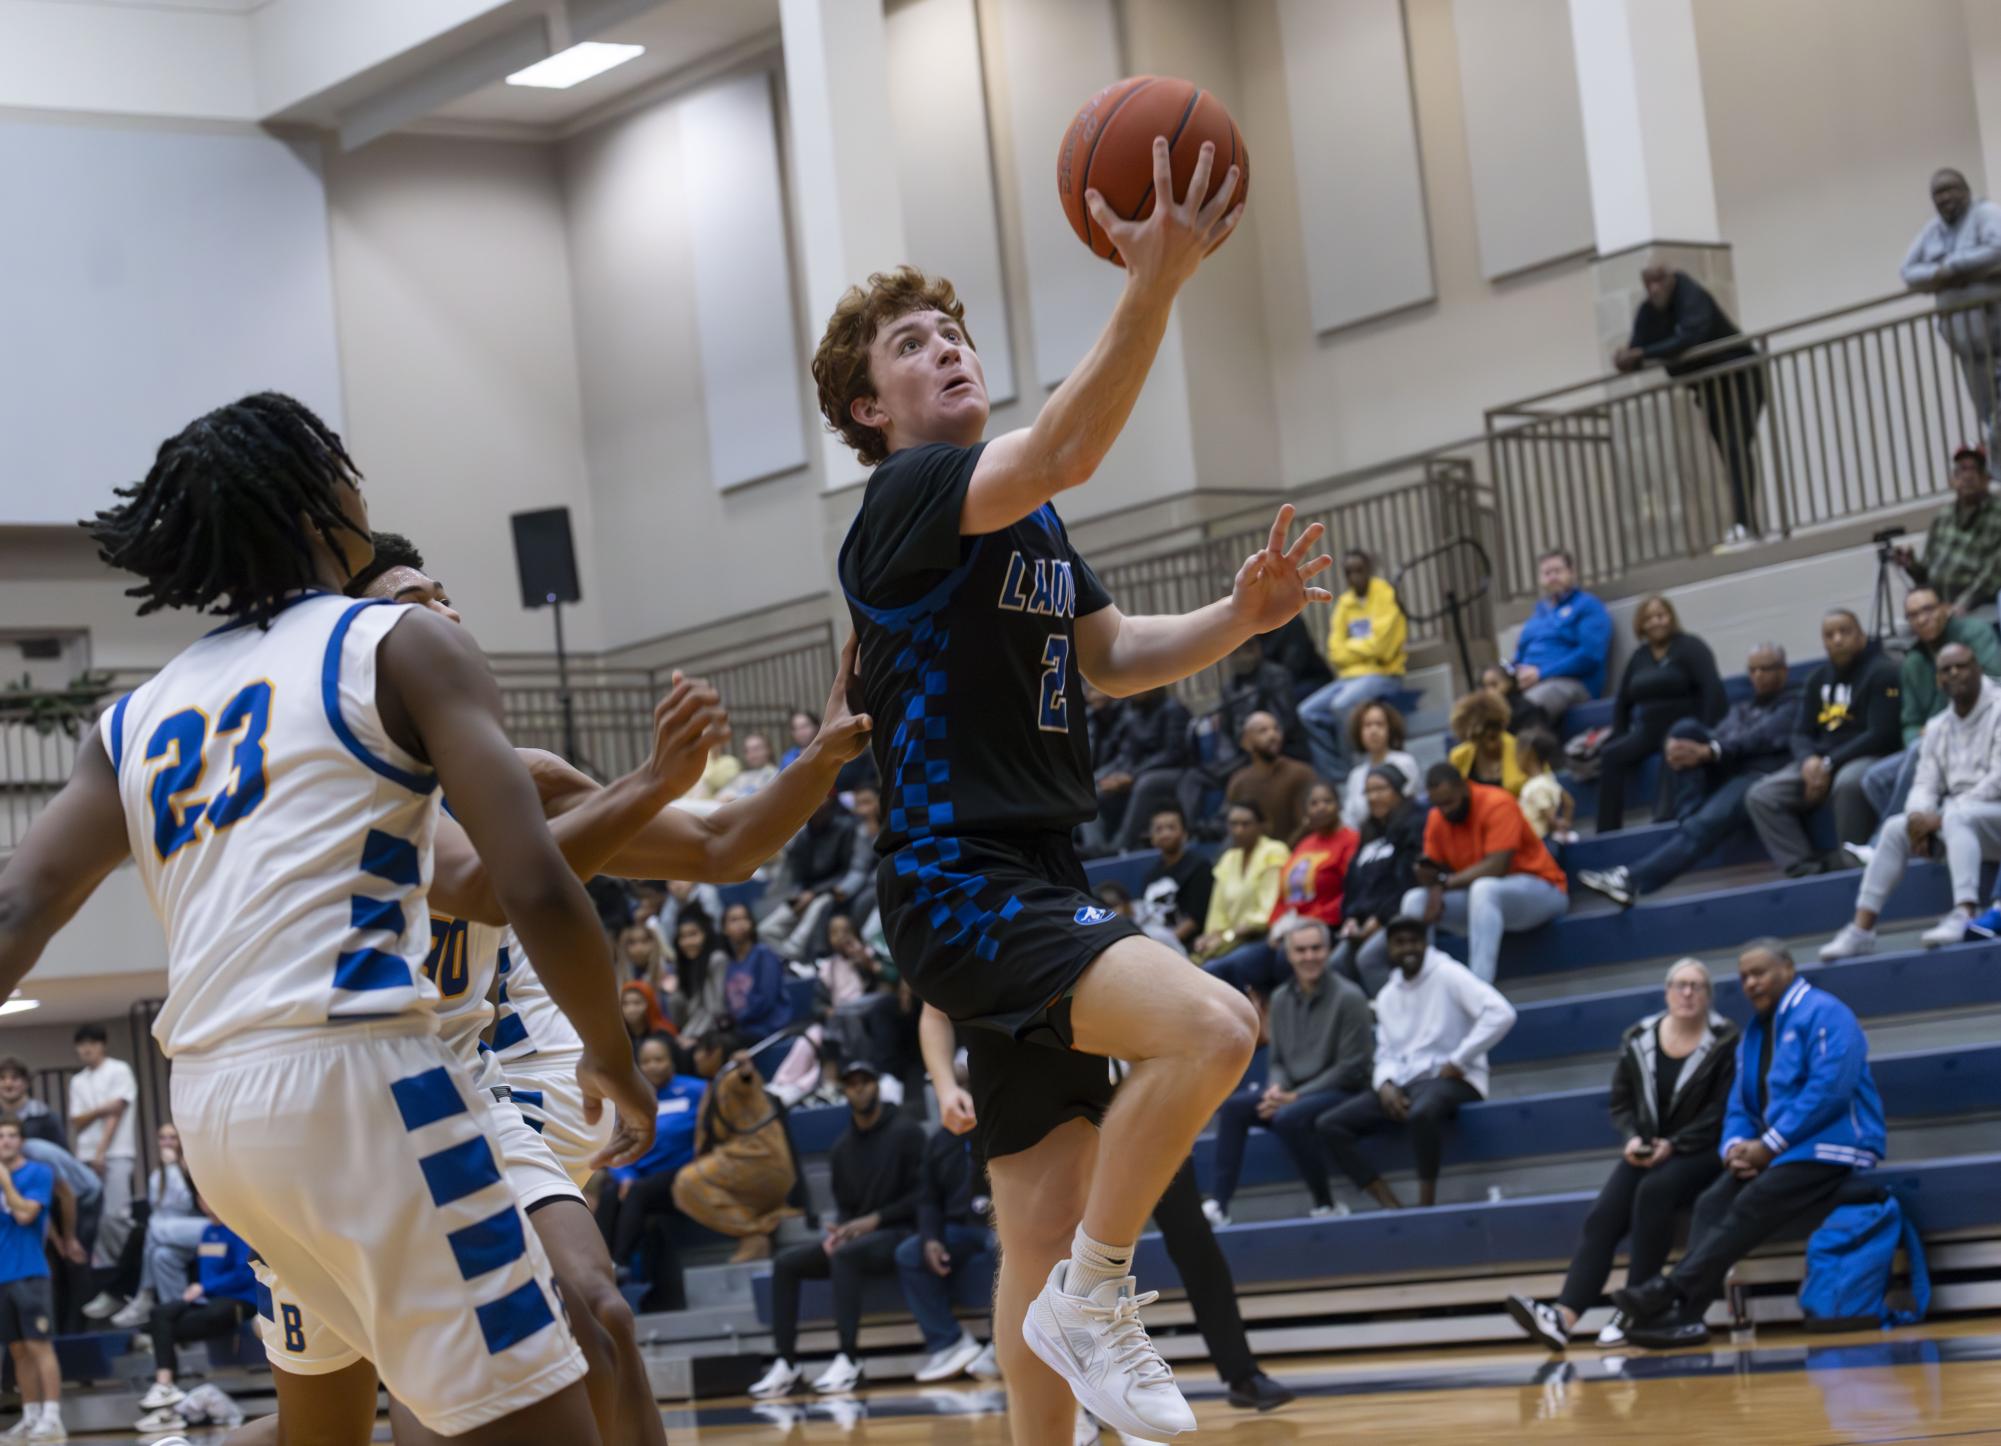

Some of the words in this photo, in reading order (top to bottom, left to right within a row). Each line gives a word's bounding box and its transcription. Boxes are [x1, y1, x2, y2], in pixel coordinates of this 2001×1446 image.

[1038, 633, 1069, 734] 2
[143, 677, 276, 864] 23
[280, 1302, 306, 1353] B
